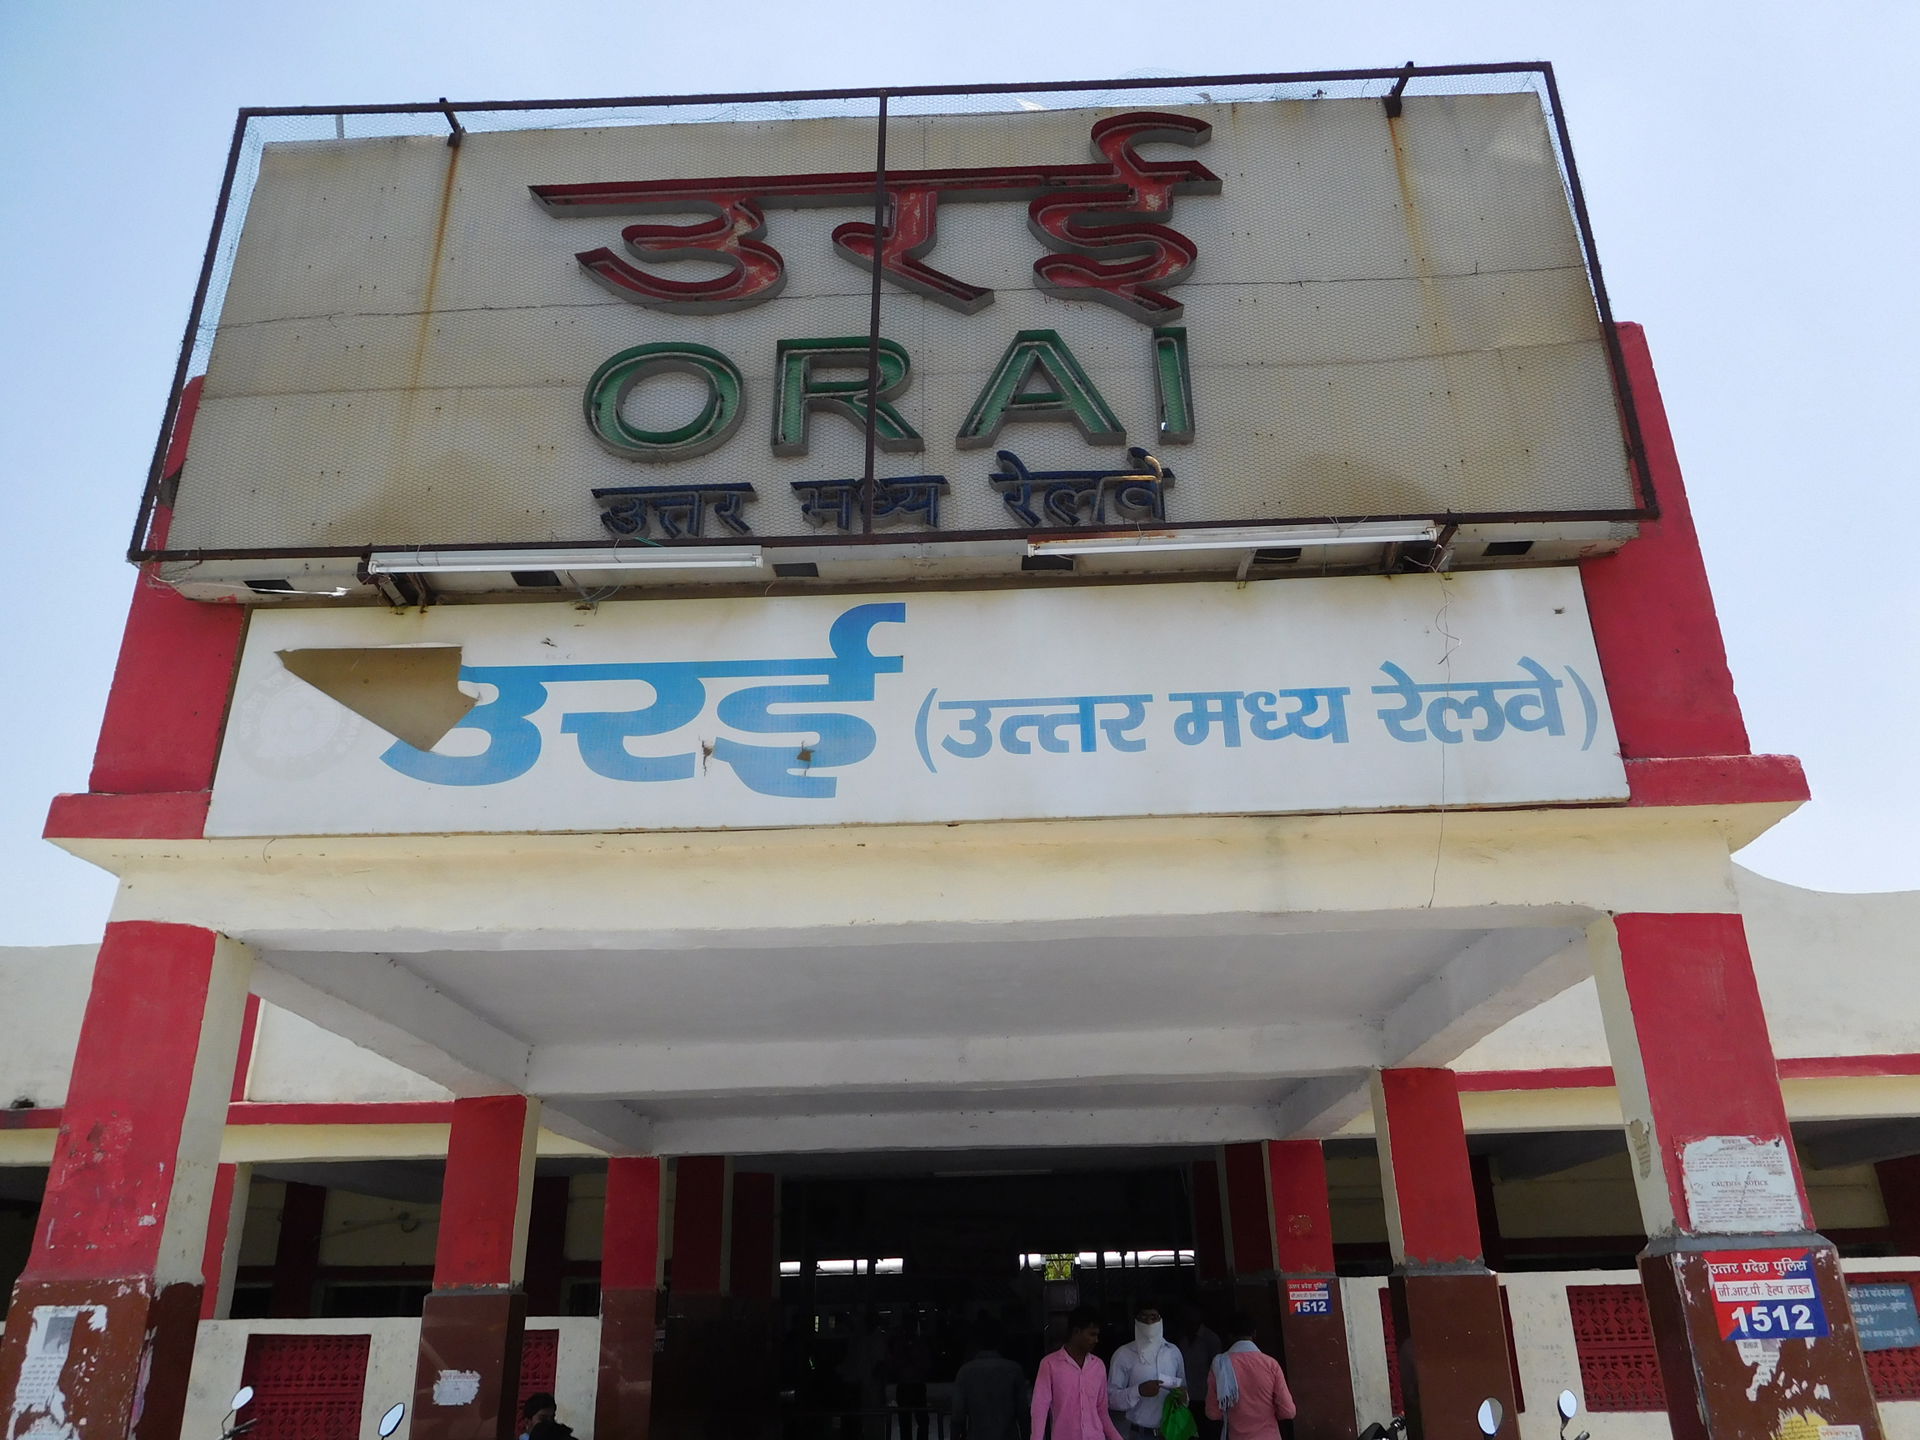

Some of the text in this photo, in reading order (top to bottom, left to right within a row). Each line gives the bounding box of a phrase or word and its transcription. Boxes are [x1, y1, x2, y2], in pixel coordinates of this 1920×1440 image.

[528, 111, 1223, 325] उरई
[582, 327, 1196, 463] ORAI
[590, 446, 1176, 539] उत्तर मध्य रेलवे
[378, 602, 906, 799] उरई
[914, 687, 1154, 774] (उत्तर
[1168, 686, 1351, 748] मध्य
[1369, 655, 1598, 752] रेलवे)
[1710, 1257, 1808, 1276] उत्तर प्रदेश पुलिस
[1765, 1282, 1783, 1297] हेल्प
[1787, 1284, 1811, 1295] लाइन
[1295, 1301, 1327, 1312] 1512
[1731, 1304, 1815, 1333] 1512
